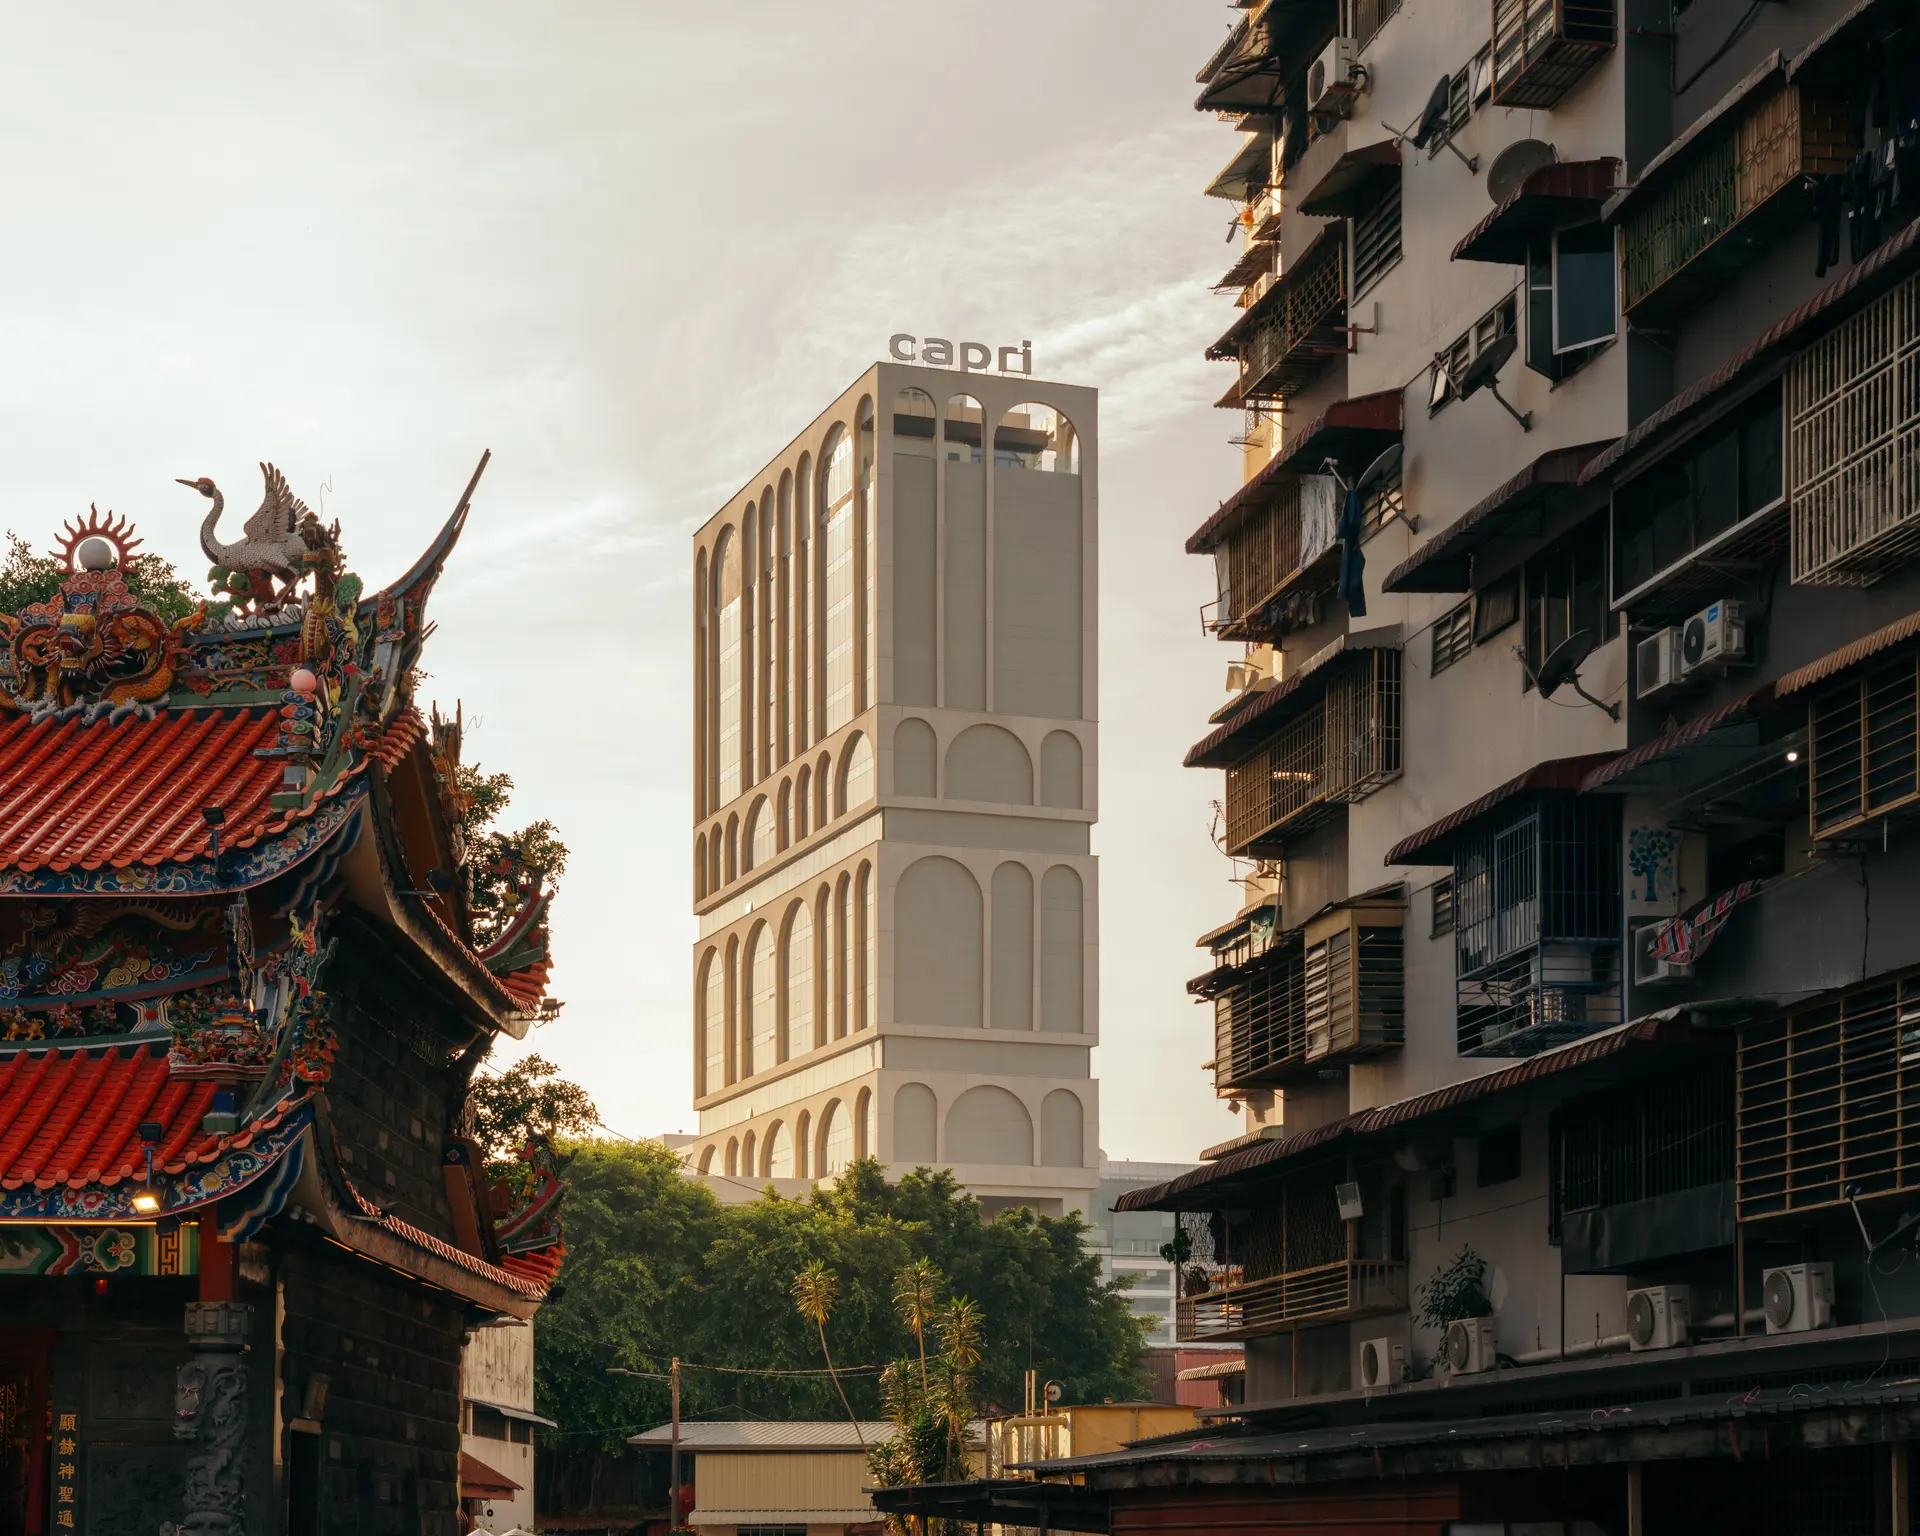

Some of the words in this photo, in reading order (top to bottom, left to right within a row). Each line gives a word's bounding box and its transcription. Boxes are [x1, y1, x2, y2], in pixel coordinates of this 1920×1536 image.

[889, 333, 1032, 375] capri
[57, 1413, 77, 1536] 顯赫神聖通
